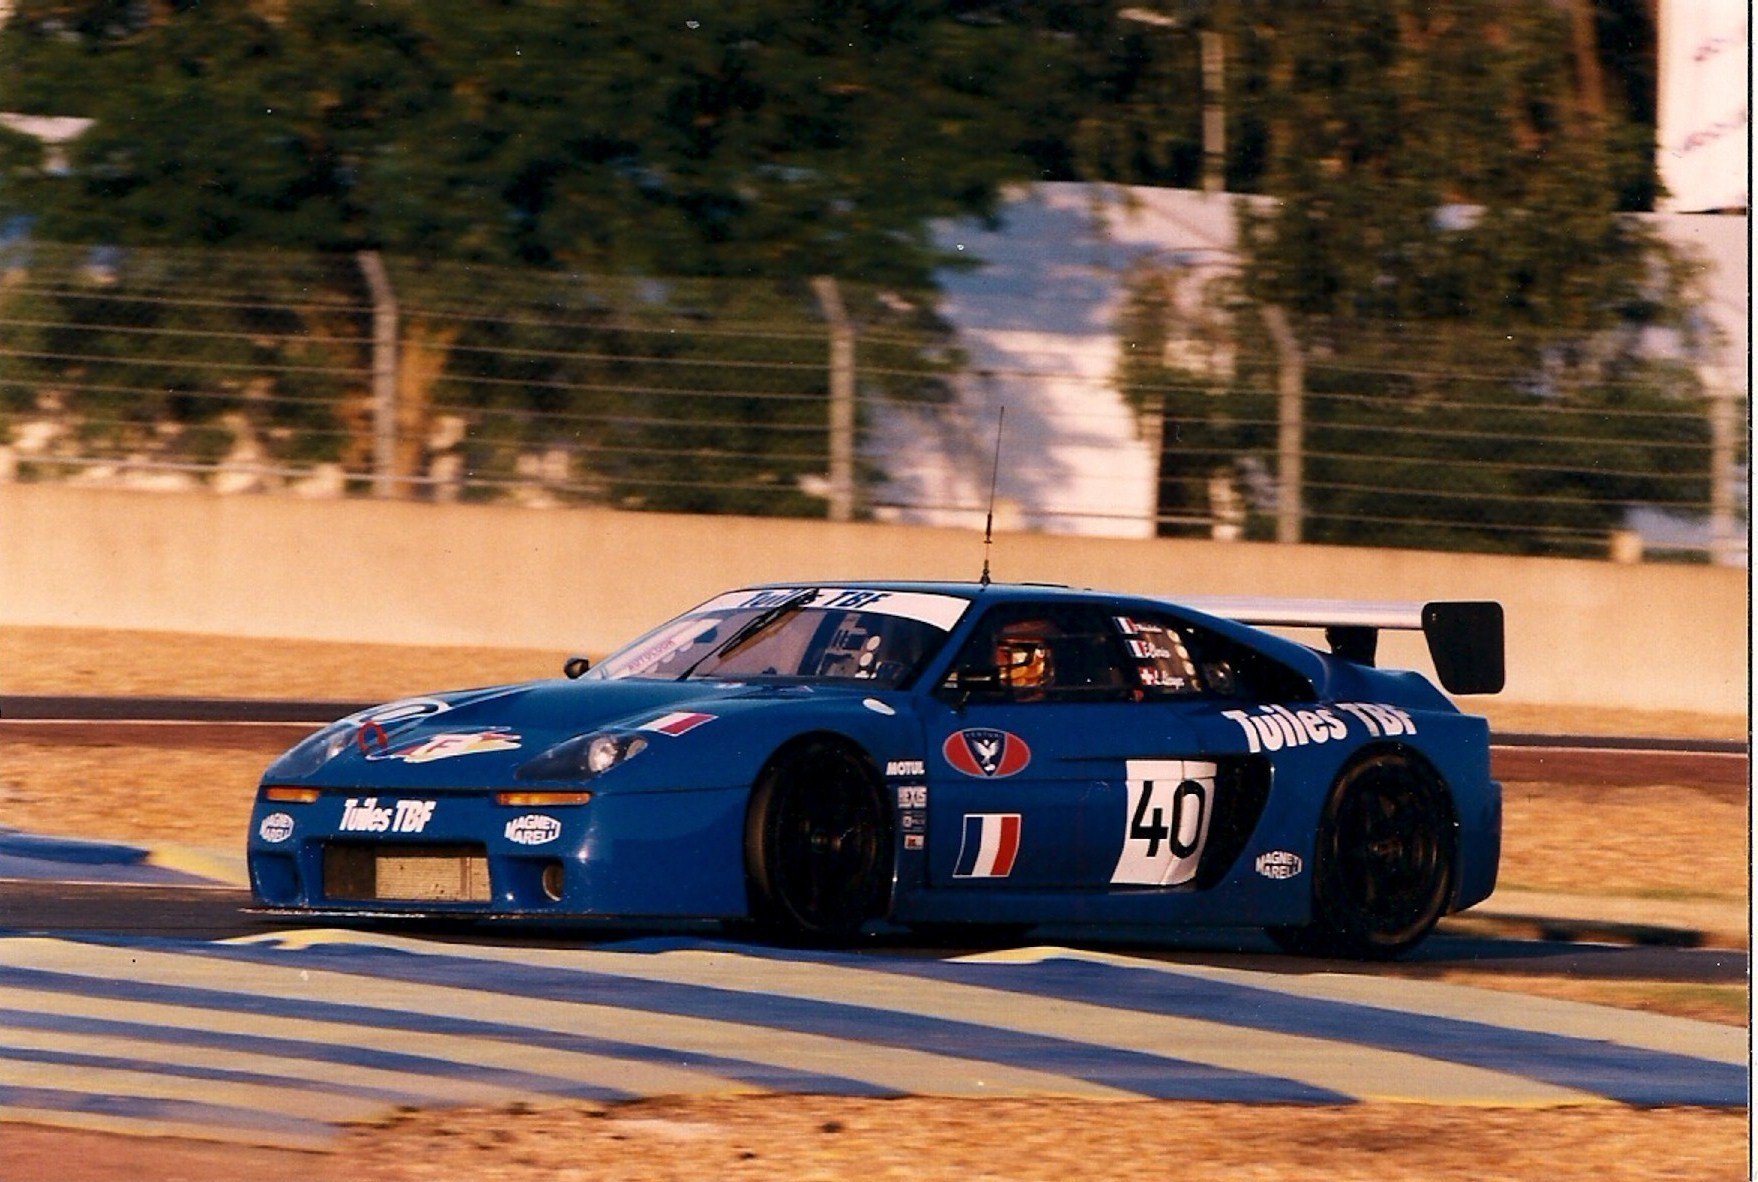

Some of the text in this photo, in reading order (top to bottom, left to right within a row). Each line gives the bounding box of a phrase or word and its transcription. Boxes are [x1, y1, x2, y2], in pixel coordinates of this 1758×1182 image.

[740, 588, 890, 609] Tuils TBF
[1221, 702, 1417, 753] Tuiles TBF
[886, 760, 925, 776] MOTUL
[339, 797, 437, 833] Tuiles TBF
[506, 814, 561, 830] MAGNETI
[1129, 779, 1205, 859] 40
[504, 826, 560, 845] MARELLI
[1256, 863, 1301, 879] MARELLI
